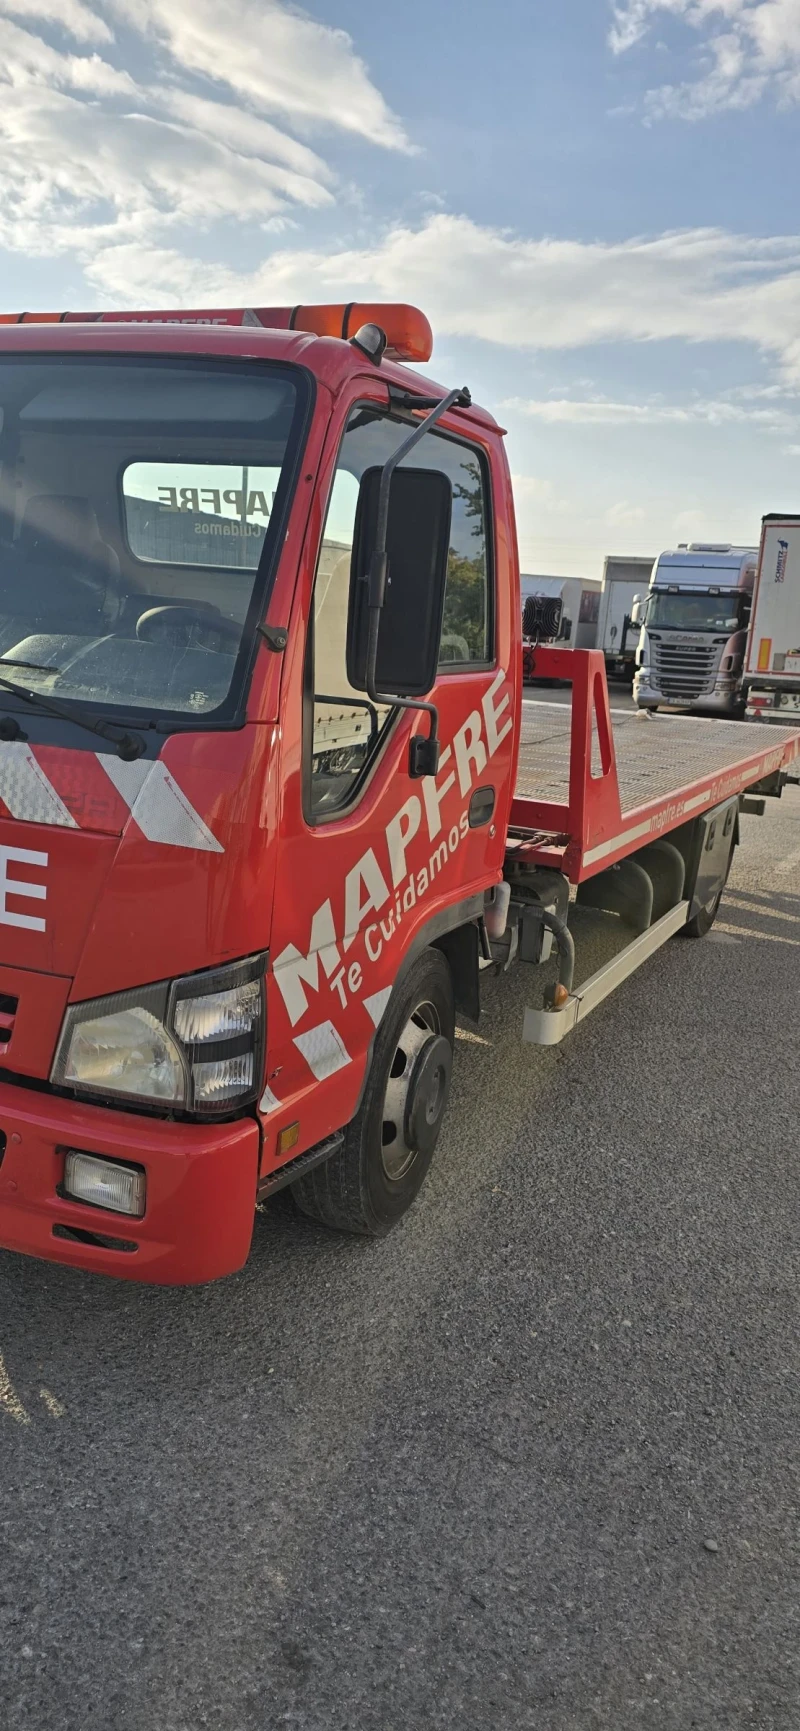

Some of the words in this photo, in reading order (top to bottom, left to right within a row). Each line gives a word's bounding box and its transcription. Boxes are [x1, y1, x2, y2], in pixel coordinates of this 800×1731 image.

[775, 550, 783, 583] SCHMITZ
[272, 669, 513, 1028] MAPFRE
[330, 958, 363, 1010] Te
[364, 809, 470, 962] Cuidamos
